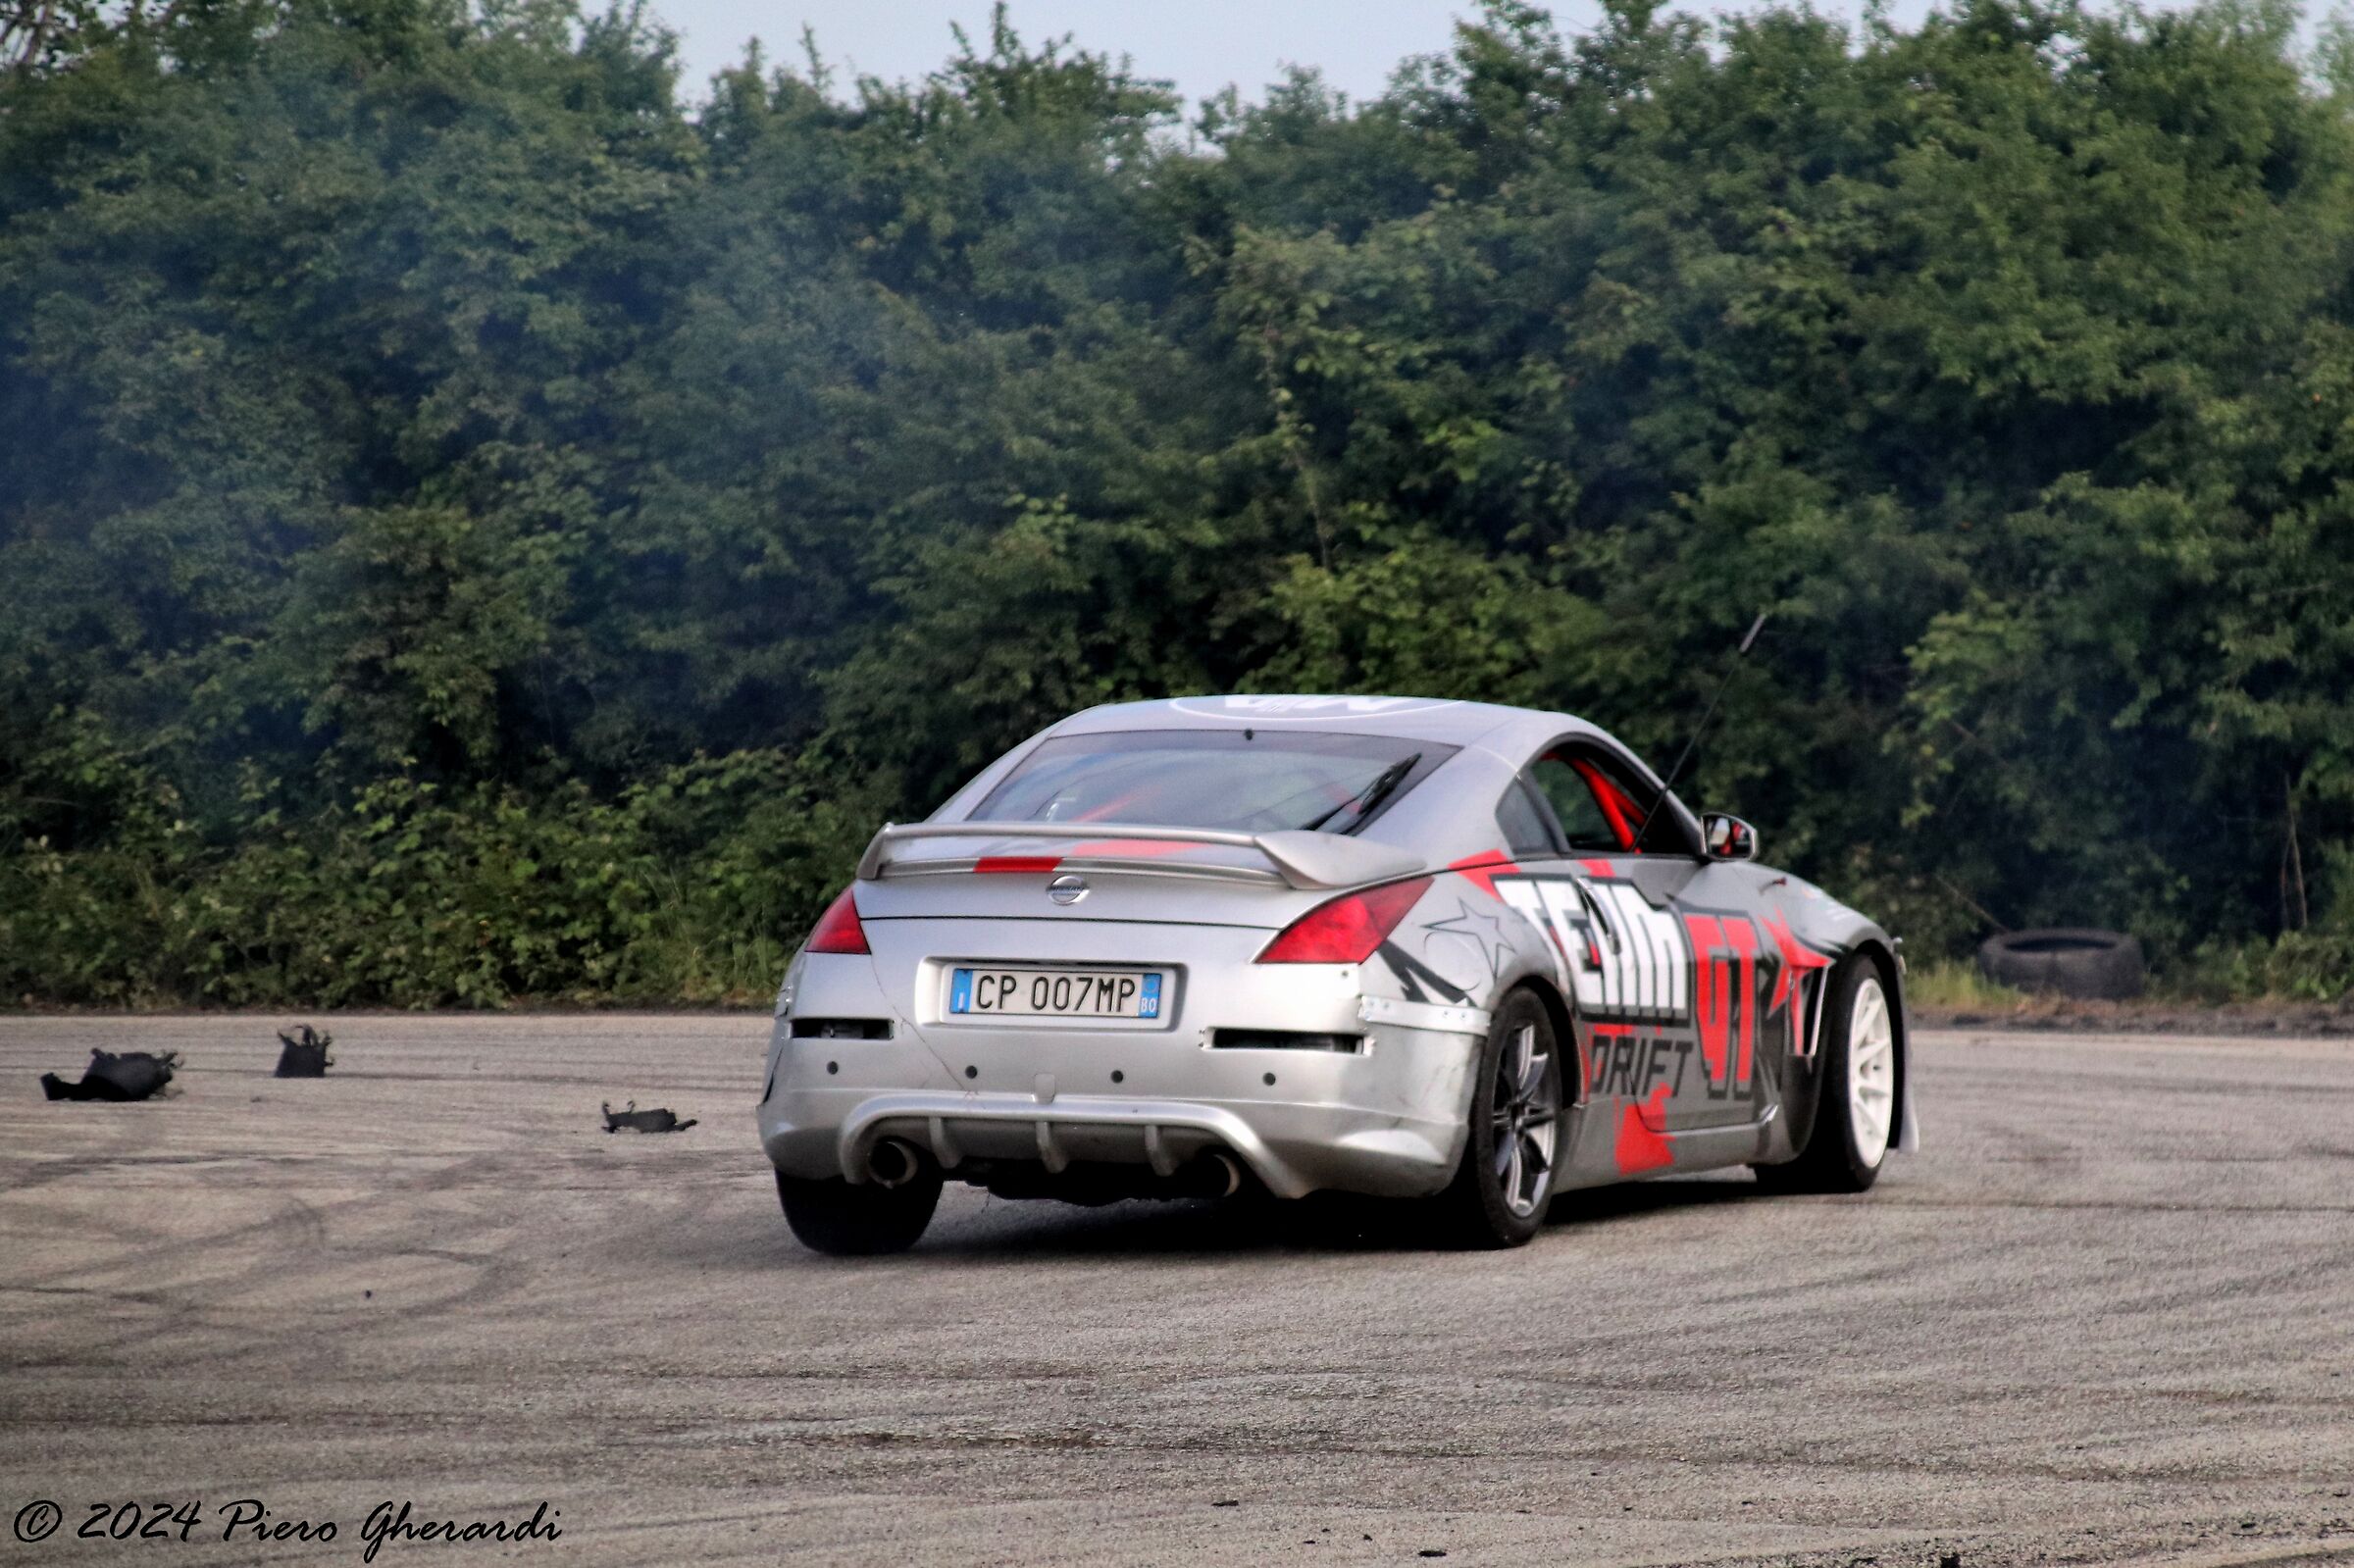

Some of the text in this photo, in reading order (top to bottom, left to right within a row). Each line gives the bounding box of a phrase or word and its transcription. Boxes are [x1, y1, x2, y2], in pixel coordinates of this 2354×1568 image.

[975, 974, 1136, 1013] CP 007MP
[1590, 1034, 1694, 1099] DRIFT
